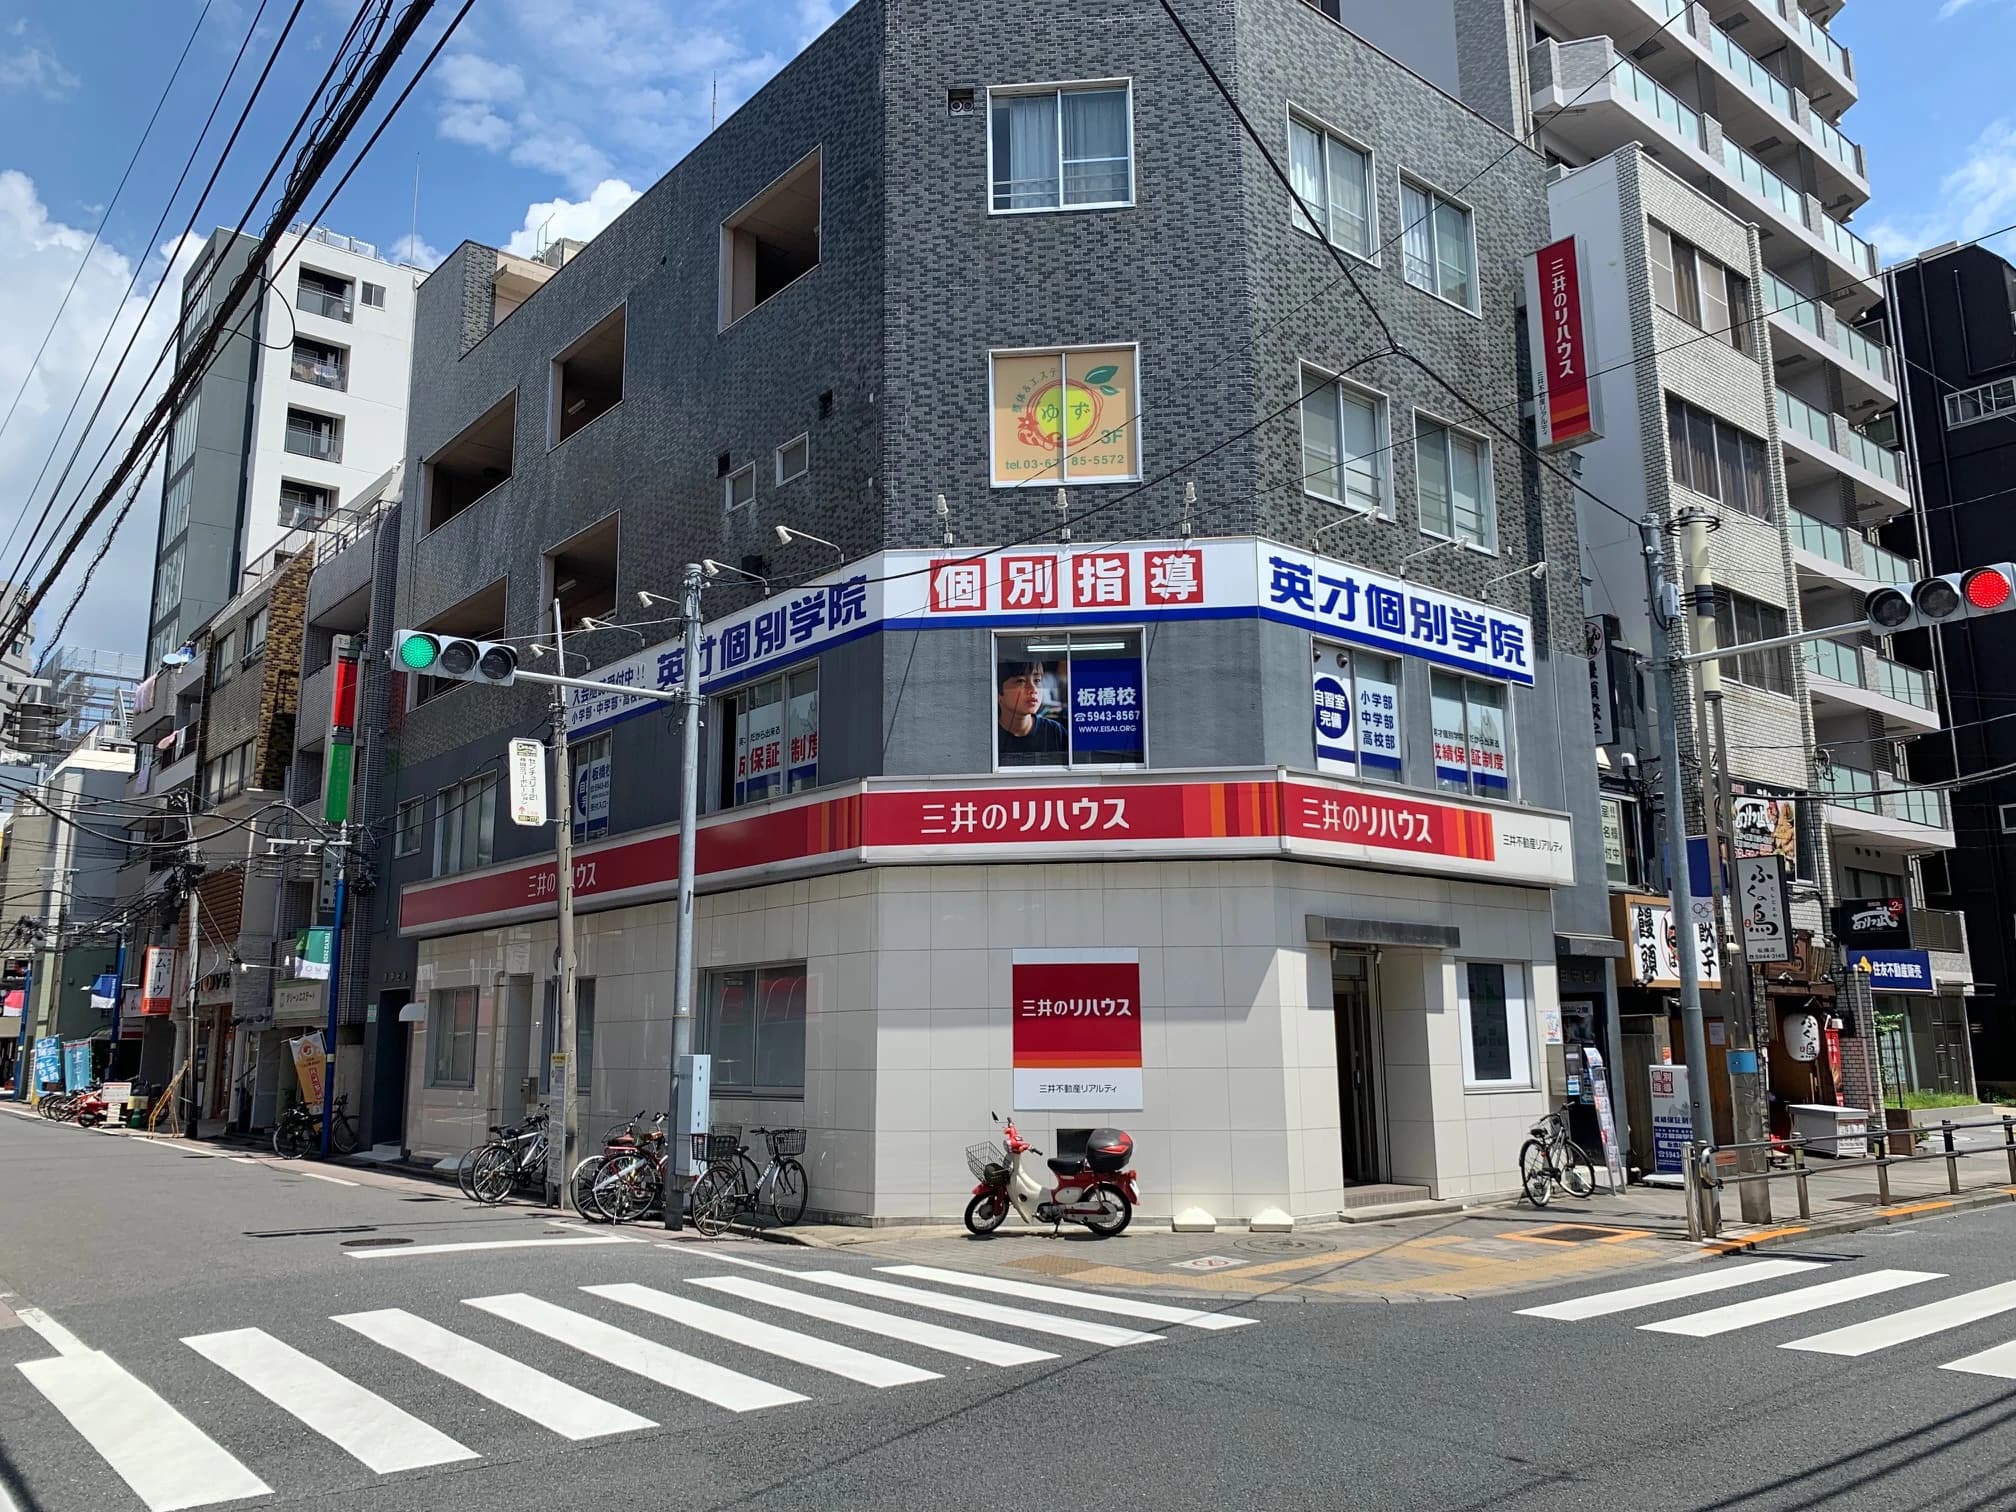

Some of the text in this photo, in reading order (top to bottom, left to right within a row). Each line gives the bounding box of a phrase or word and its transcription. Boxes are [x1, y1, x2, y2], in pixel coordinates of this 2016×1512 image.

[1551, 258, 1574, 378] 三井のリハウス
[1101, 429, 1123, 444] 3F
[934, 554, 1198, 608] 個別指導
[1269, 556, 1526, 667] 英才個別学院
[657, 574, 867, 691] 英才個別学院
[1077, 687, 1136, 706] 板橋校
[1314, 690, 1346, 711] 自習室
[1361, 690, 1393, 710] 小学部
[1087, 710, 1140, 721] 5943-8567
[1320, 710, 1342, 729] 完備
[1362, 710, 1394, 730] 中学部
[1078, 725, 1137, 733] WWW.EISAI.ORG
[1362, 730, 1395, 750] 高校部
[921, 798, 1130, 834] 三井のリハウス
[1302, 798, 1432, 844] 三井のリハウス
[1503, 834, 1563, 852] 三井不動産リアルティ
[527, 862, 596, 898] 三井のウス
[1872, 961, 1923, 979] 住友不動産販売
[1022, 999, 1132, 1017] 三井のリハウス
[1039, 1084, 1117, 1093] 三井不動産リアルティ
